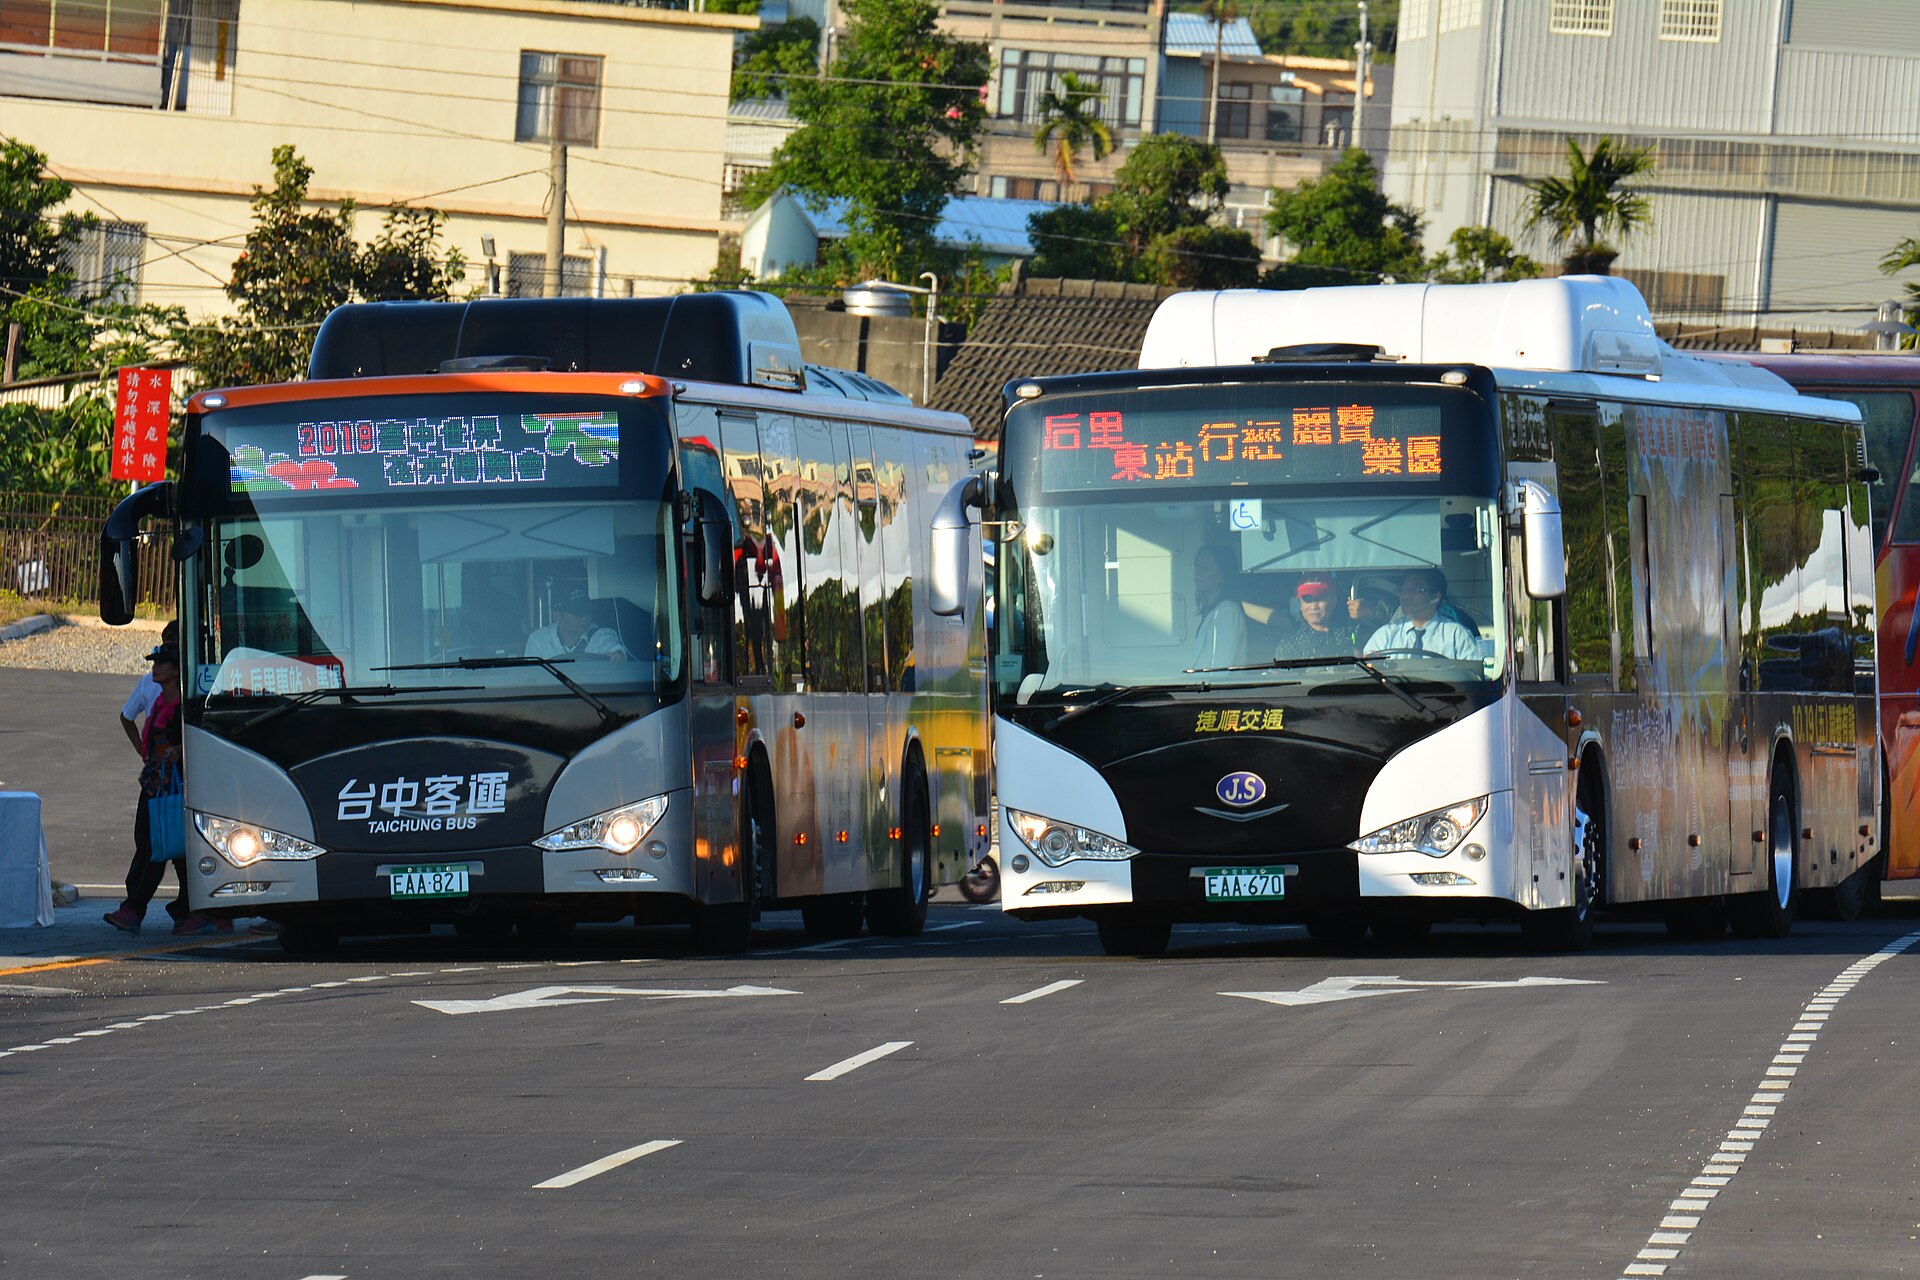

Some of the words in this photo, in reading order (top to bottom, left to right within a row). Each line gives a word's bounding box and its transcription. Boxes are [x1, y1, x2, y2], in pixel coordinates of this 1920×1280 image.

[1195, 708, 1284, 733] 捷順交通
[337, 771, 509, 821] 台中客運
[1225, 777, 1256, 800] J.S
[368, 818, 442, 834] TAICHUNG
[445, 817, 477, 831] BUS
